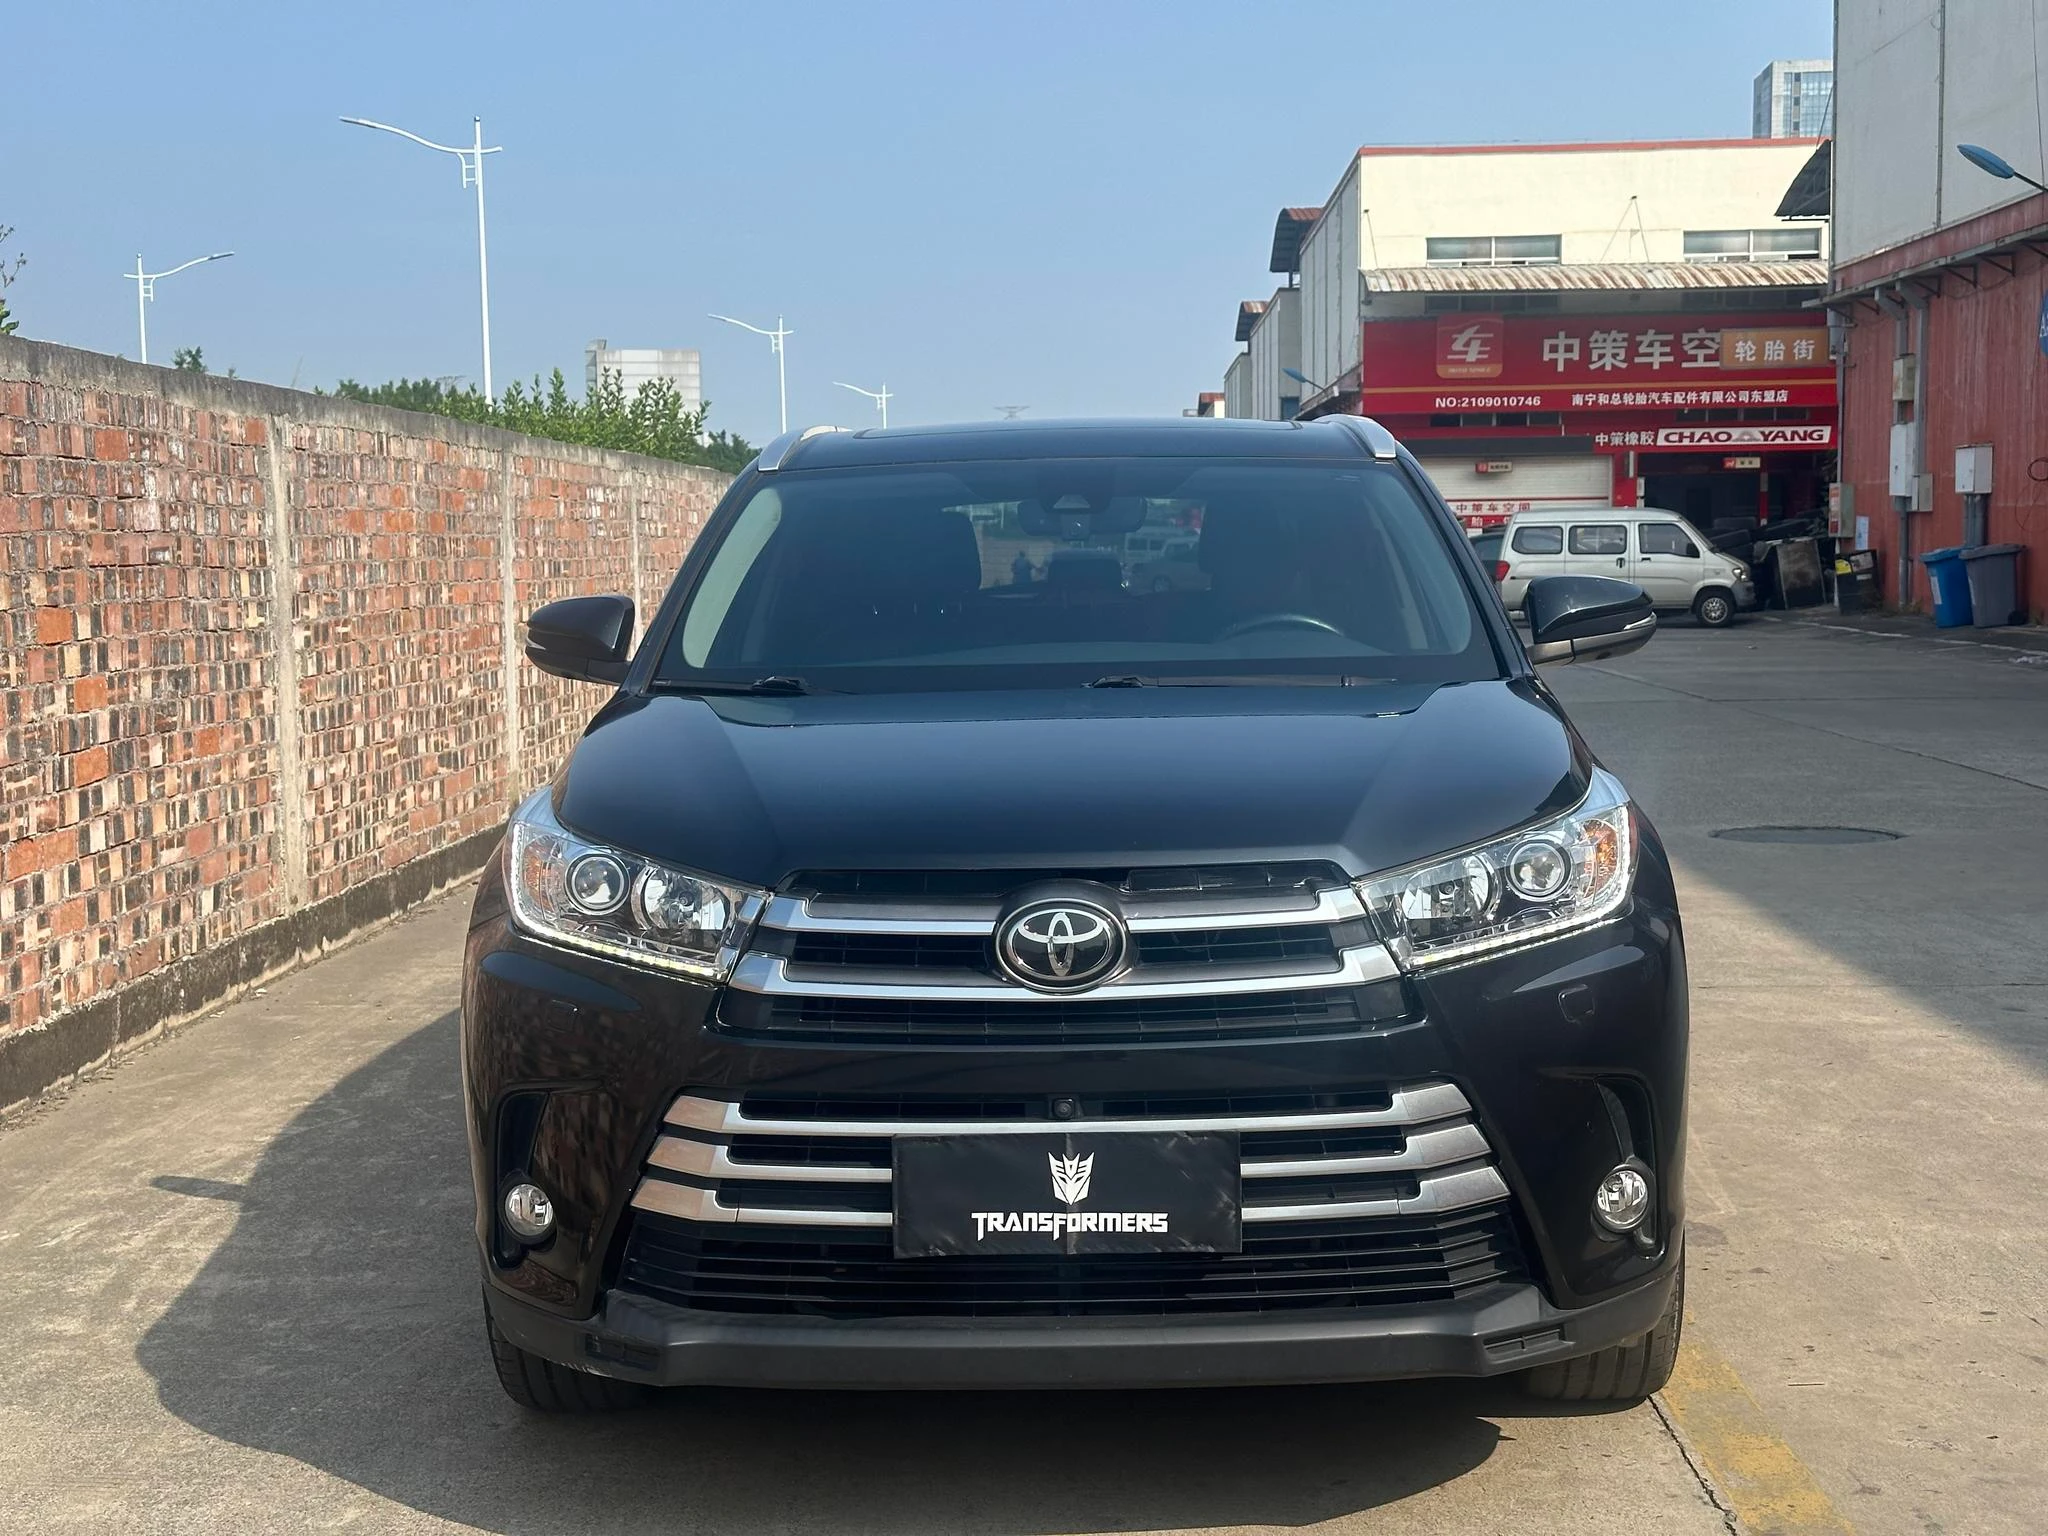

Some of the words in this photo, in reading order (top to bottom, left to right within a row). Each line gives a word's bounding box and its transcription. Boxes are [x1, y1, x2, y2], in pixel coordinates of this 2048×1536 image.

[1734, 339, 1816, 362] 轮胎街
[1435, 396, 1541, 409] NO:2109010746
[1595, 430, 1656, 447] 中策橡胶
[1663, 431, 1733, 444] CHAO
[1760, 428, 1825, 442] YANG
[970, 1212, 1169, 1241] TRANSFORMERS
